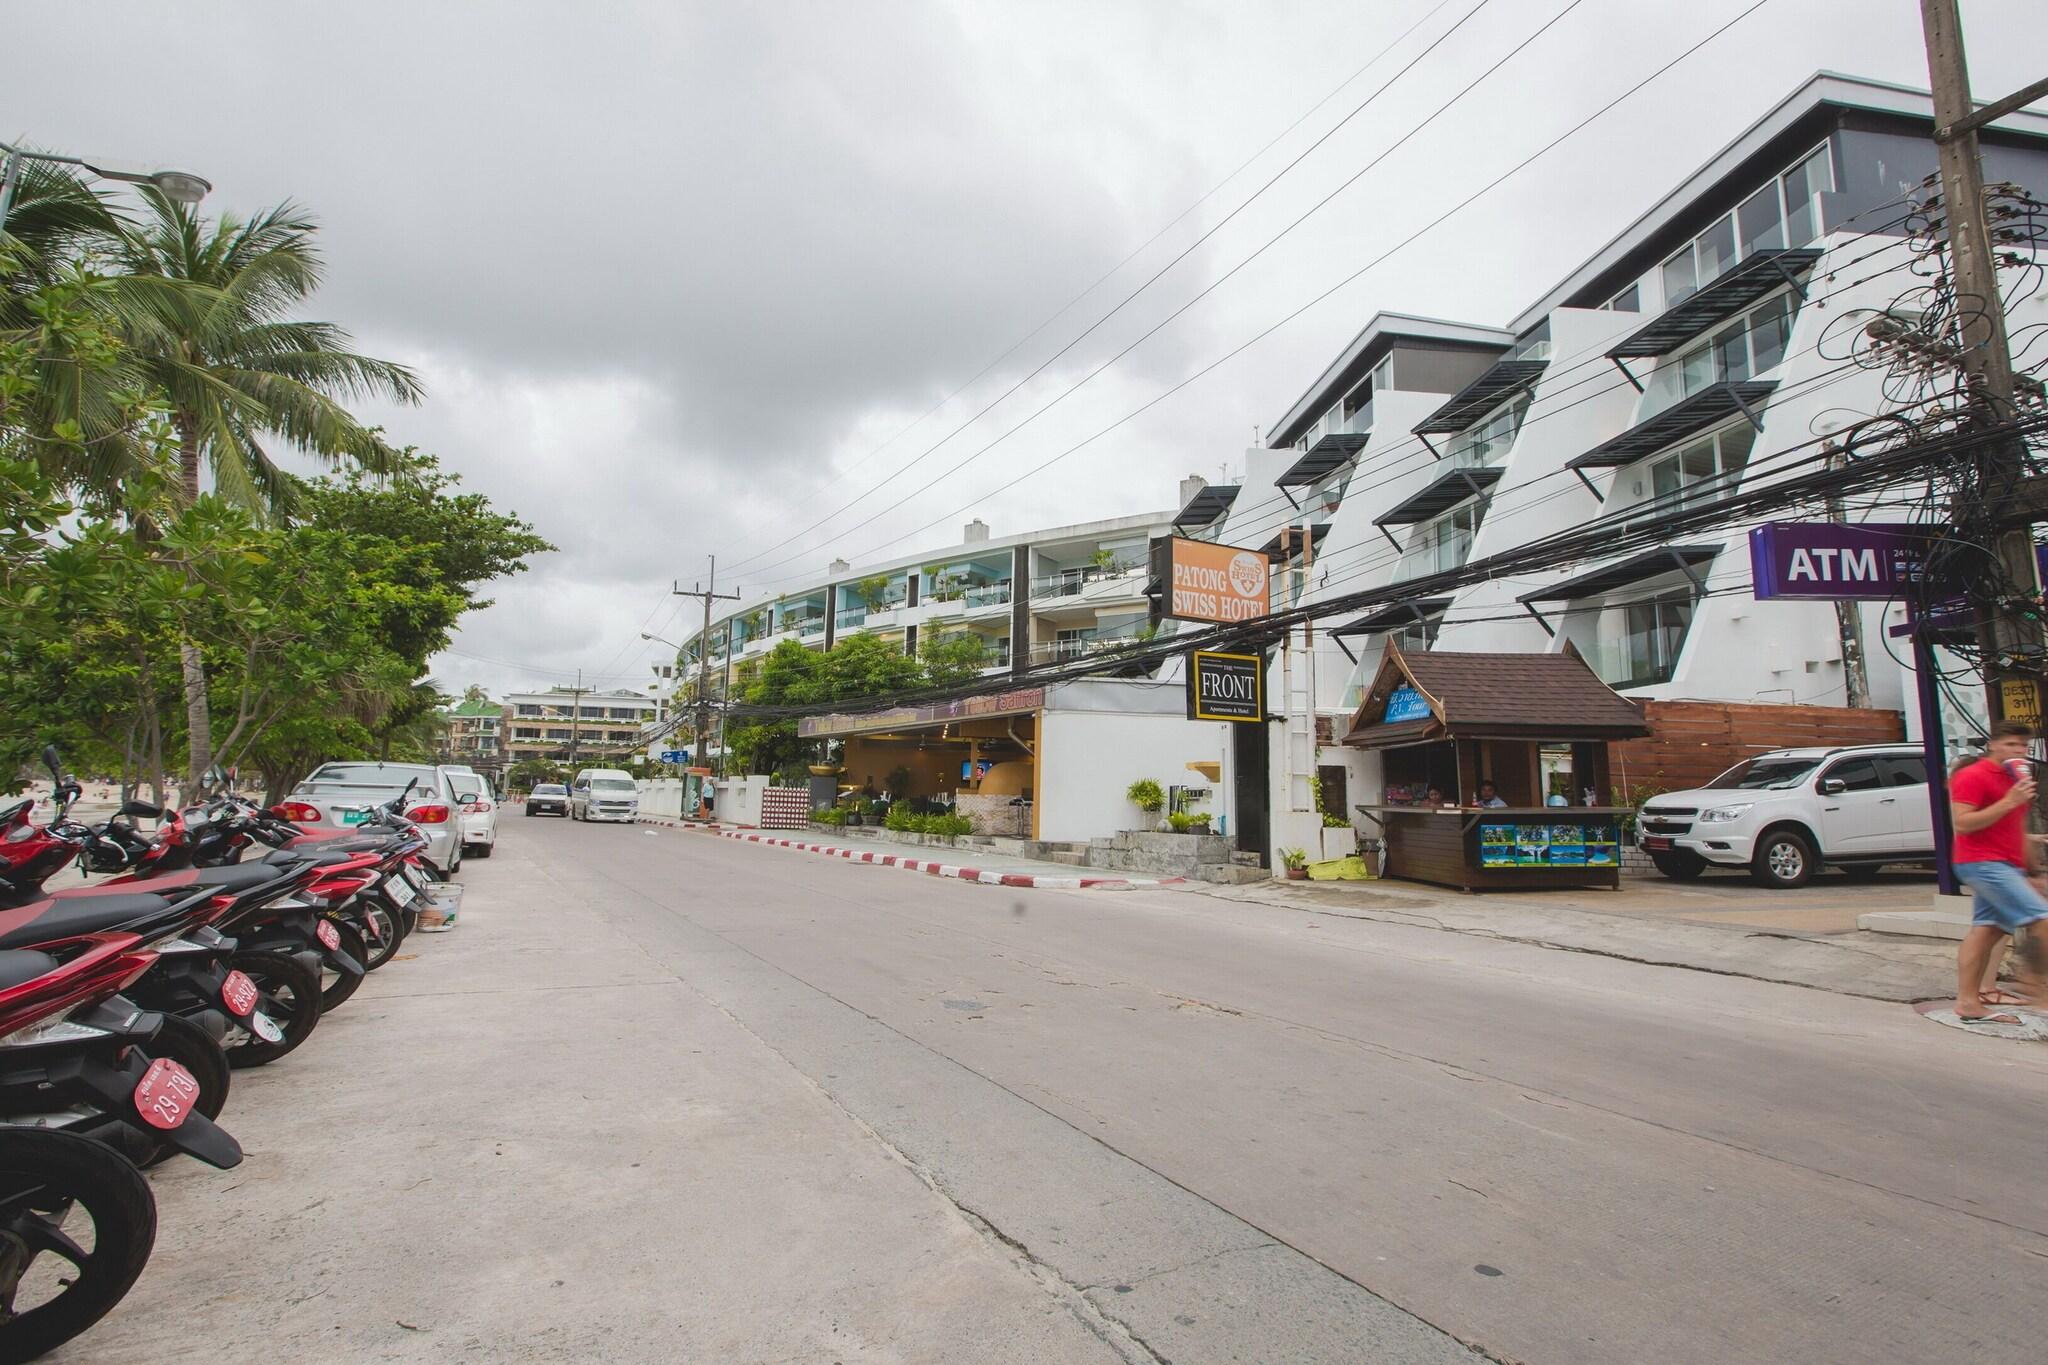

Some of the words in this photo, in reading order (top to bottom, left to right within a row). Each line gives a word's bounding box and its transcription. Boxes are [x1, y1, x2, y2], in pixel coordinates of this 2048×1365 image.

[1174, 563, 1227, 592] PATONG
[1788, 549, 1879, 581] ATM
[1173, 589, 1217, 617] SWISS
[1201, 672, 1255, 699] FRONT
